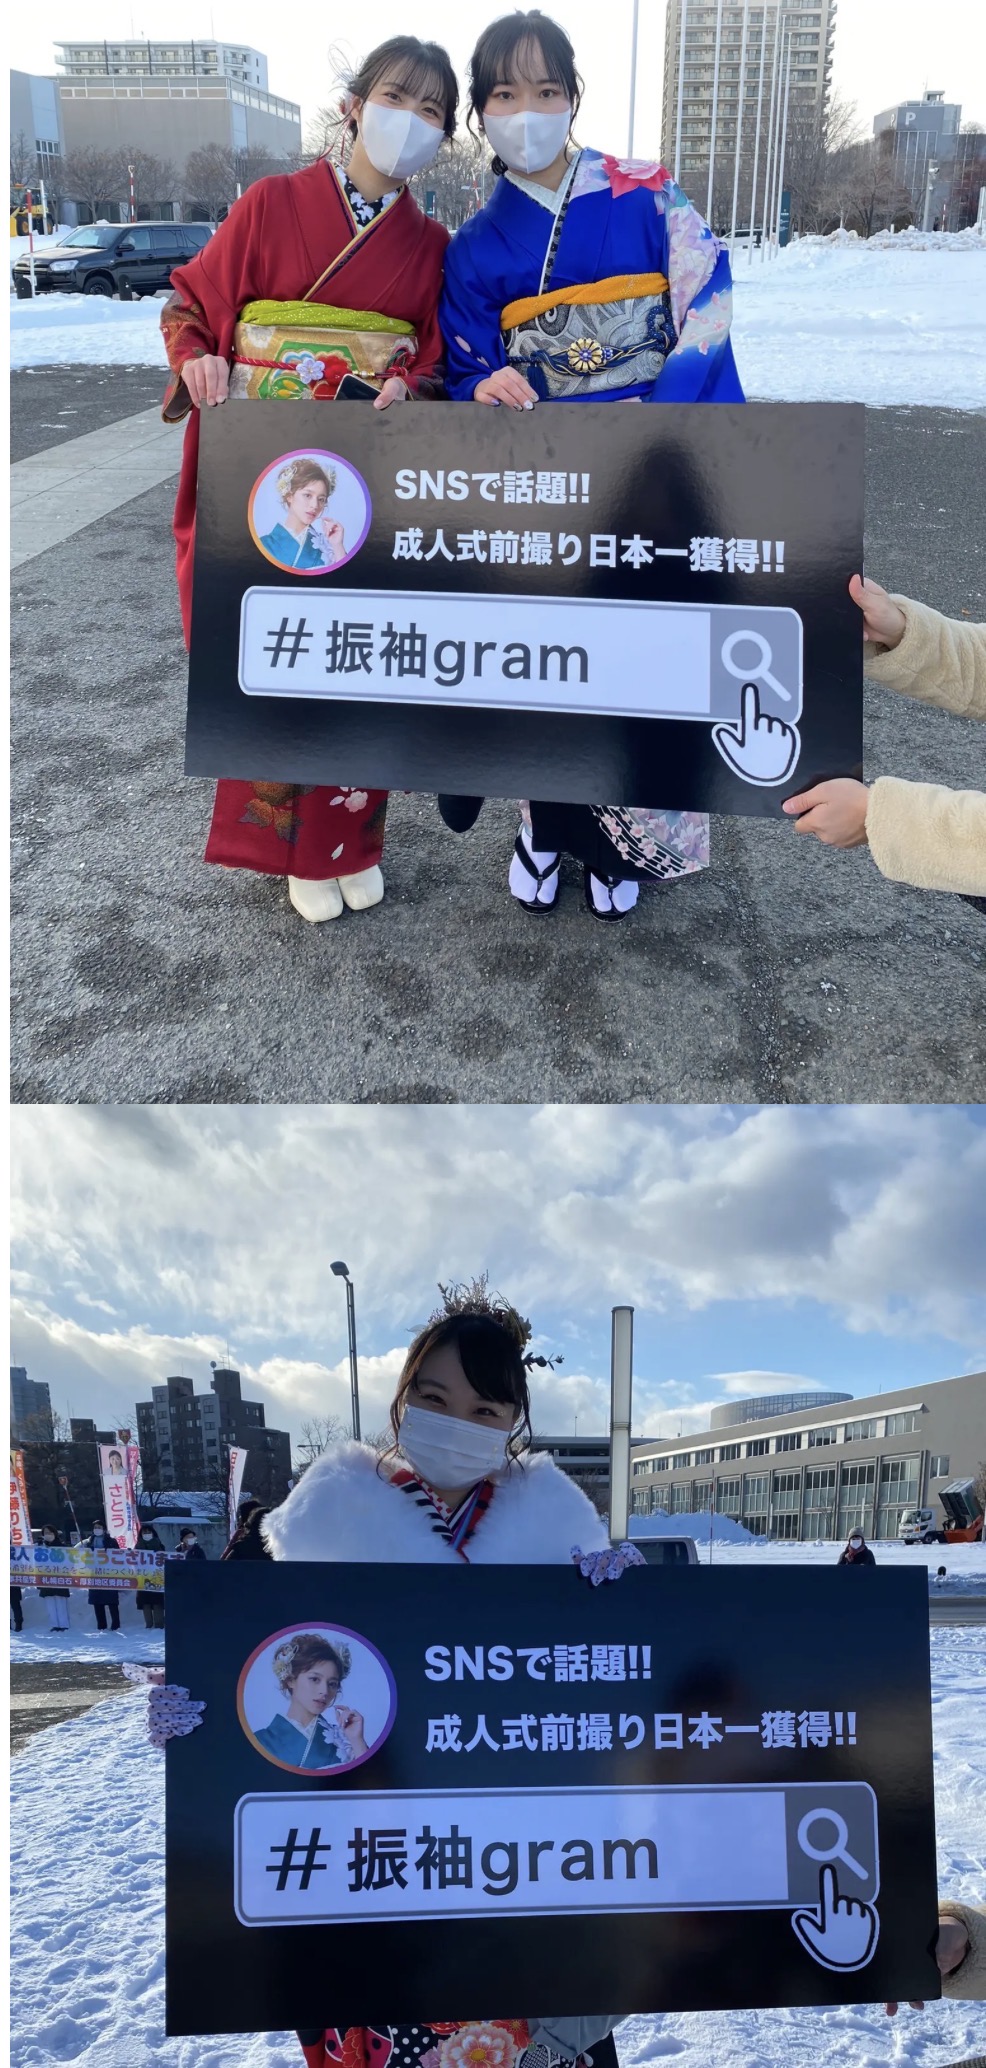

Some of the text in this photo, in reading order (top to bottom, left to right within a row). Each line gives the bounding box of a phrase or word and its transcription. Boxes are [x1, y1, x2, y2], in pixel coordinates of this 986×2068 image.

[905, 112, 917, 126] P
[394, 469, 590, 504] SNSで話題!!
[391, 527, 785, 574] 成人式前撮り日本一獲得!!
[424, 1643, 653, 1682] SNSで話題!!
[424, 1710, 857, 1753] 成人式前撮り日本一獲得!!
